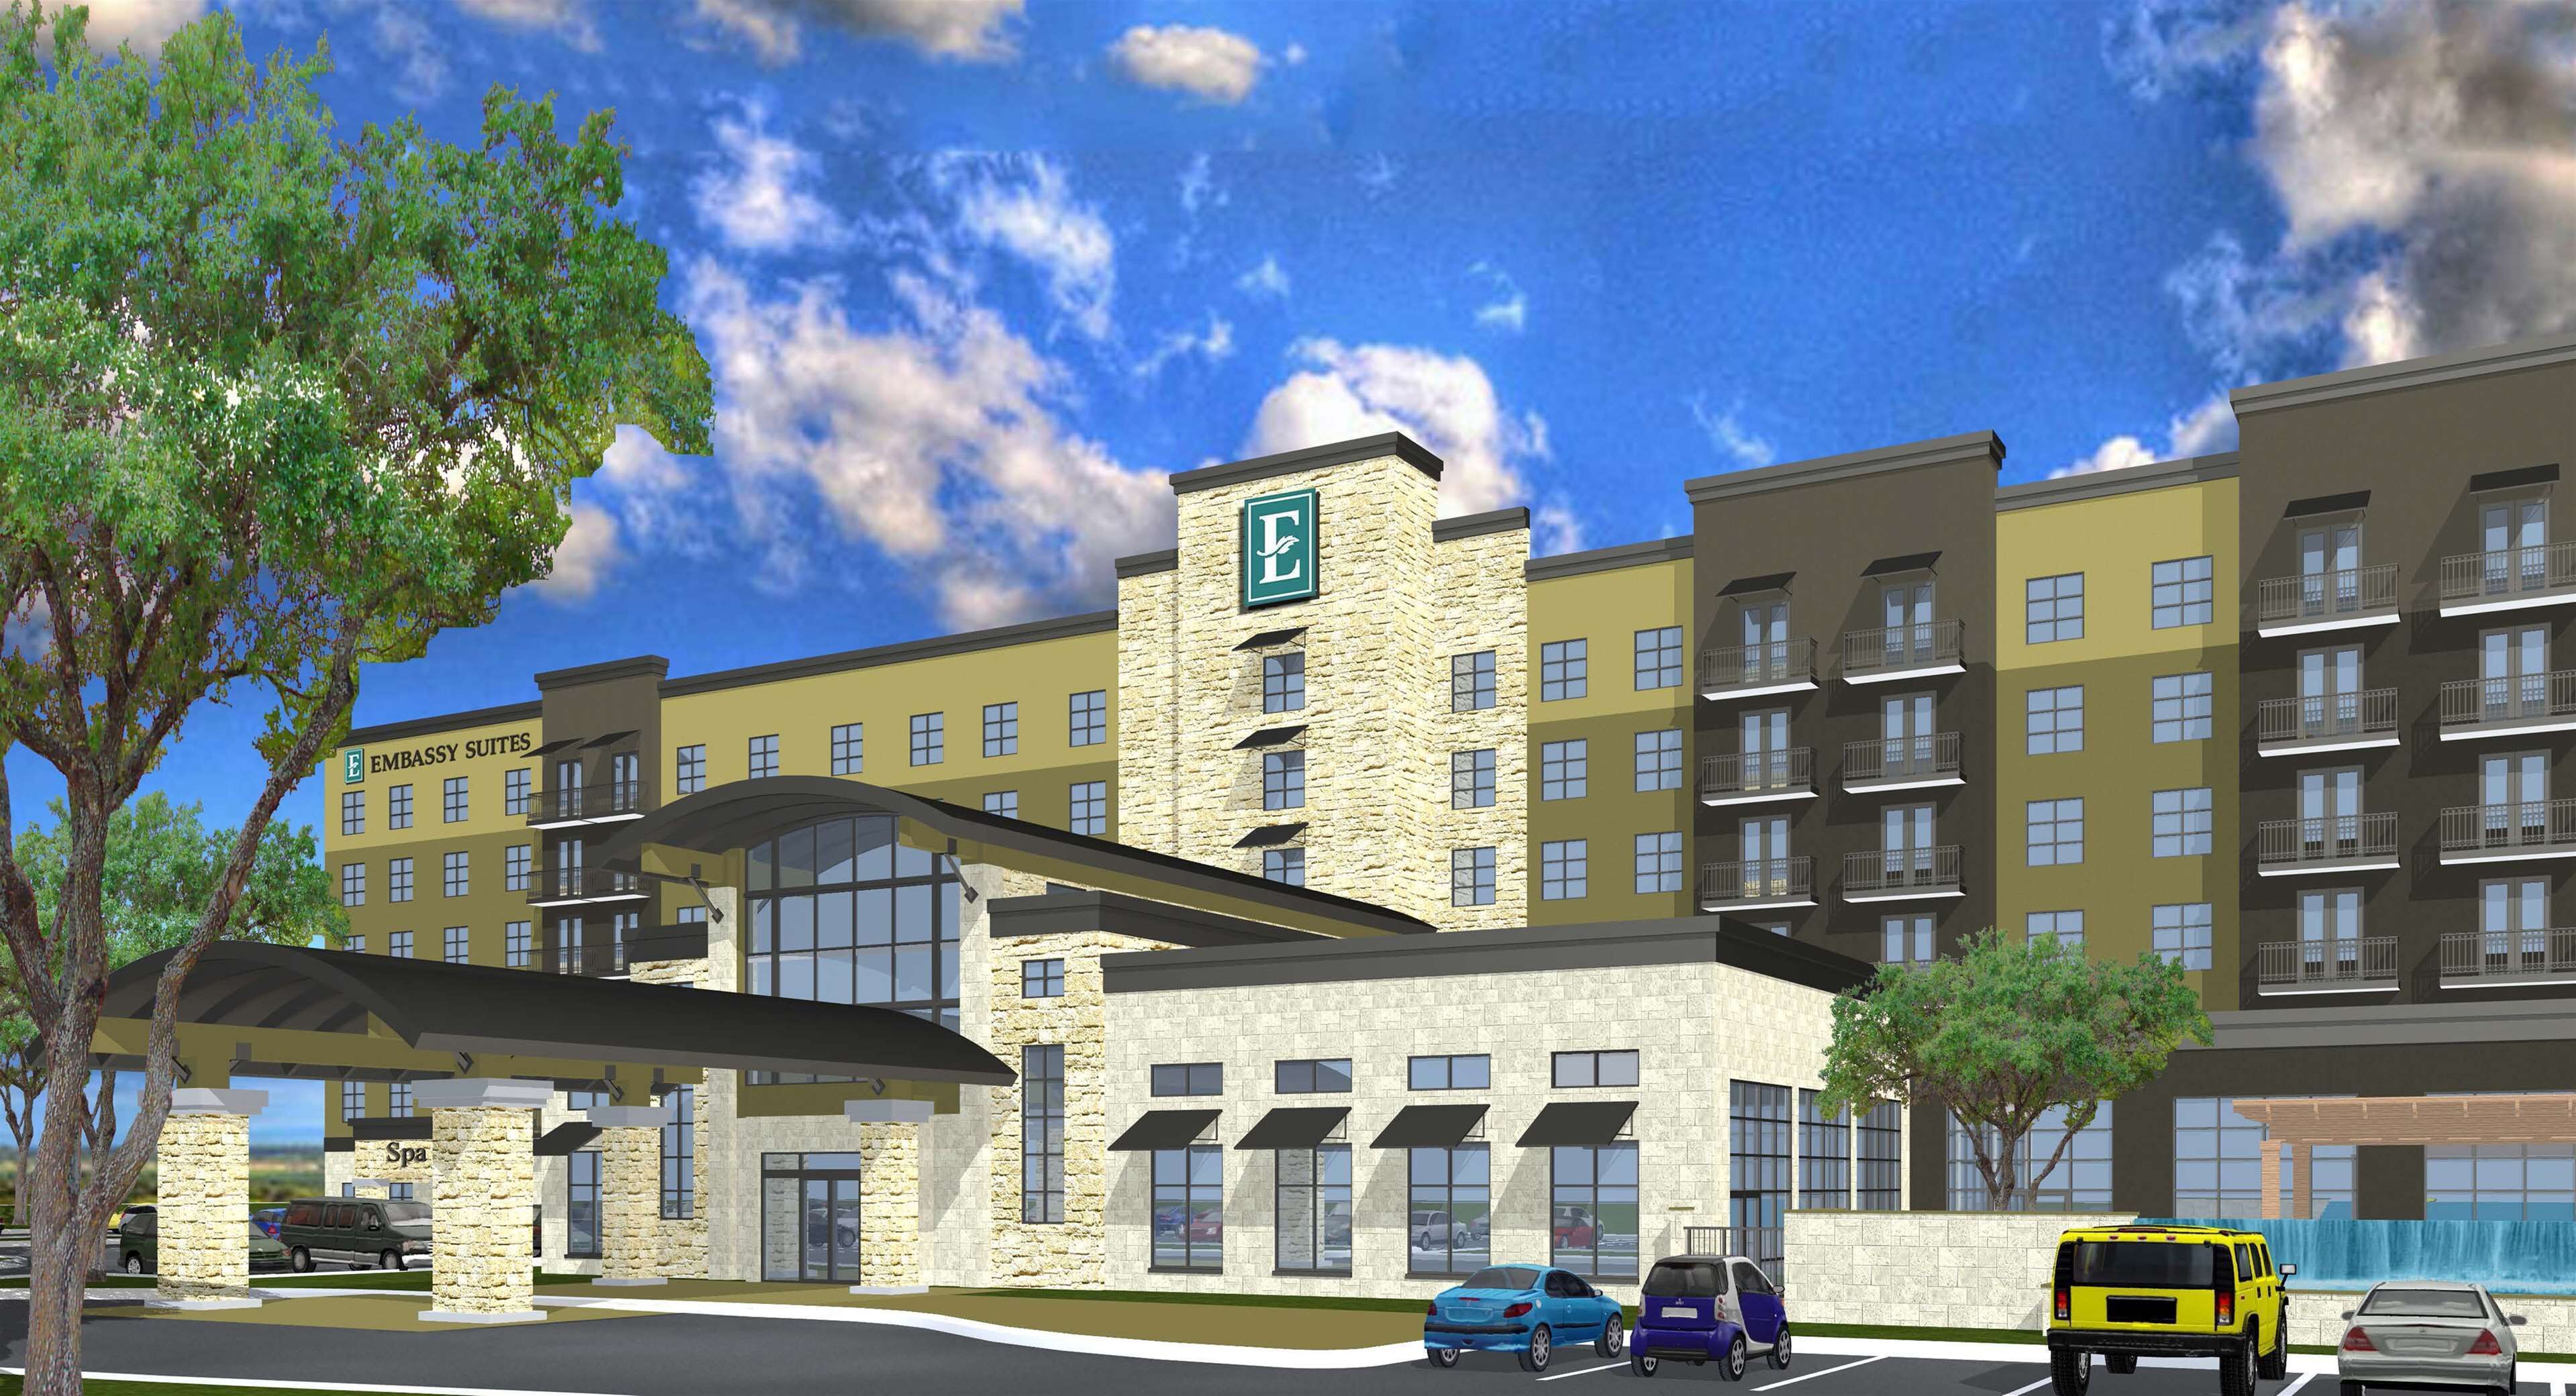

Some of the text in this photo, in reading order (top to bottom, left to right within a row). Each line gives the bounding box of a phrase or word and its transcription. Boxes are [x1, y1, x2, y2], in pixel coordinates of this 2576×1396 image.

[1257, 510, 1300, 584] E
[348, 754, 360, 777] E
[370, 733, 531, 773] EMBASSY SUITES
[387, 1142, 427, 1167] Spa
